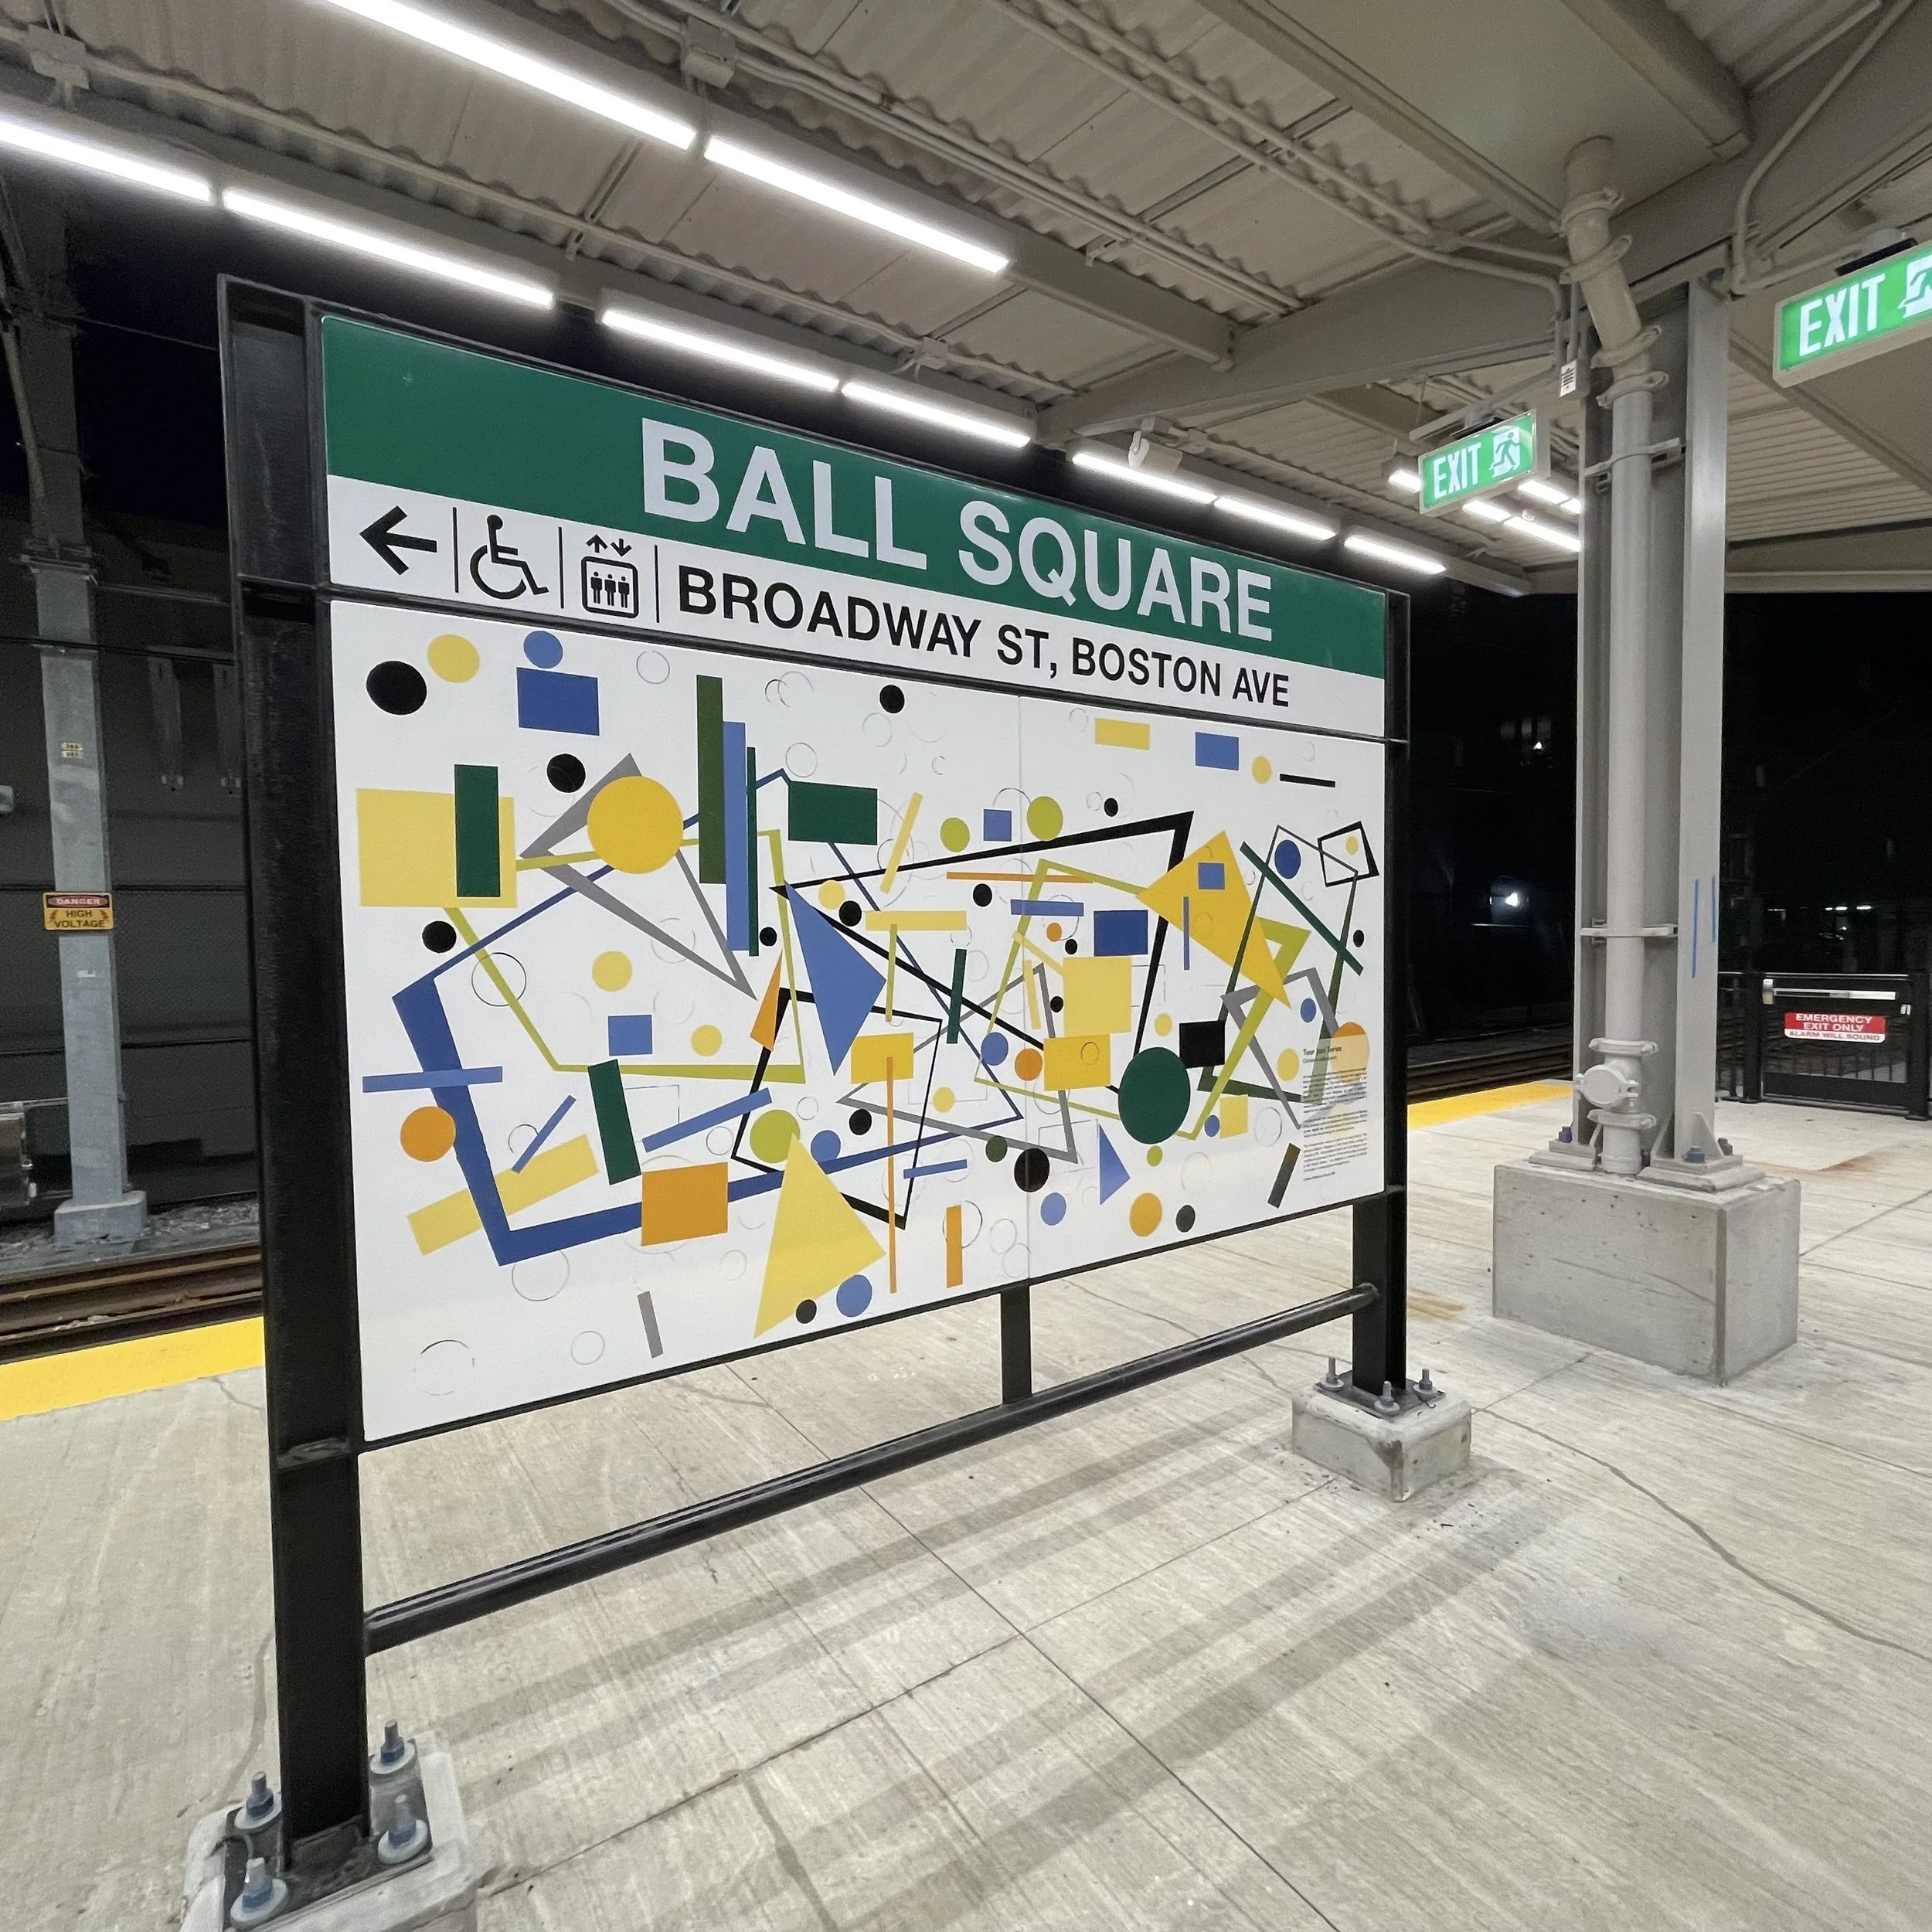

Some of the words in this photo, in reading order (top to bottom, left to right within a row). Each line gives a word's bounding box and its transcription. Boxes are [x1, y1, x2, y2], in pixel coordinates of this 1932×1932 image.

[1799, 274, 1886, 356] EXIT
[1434, 442, 1481, 499] EXIT
[642, 417, 927, 570] BALL
[958, 500, 1272, 642] SQUARE
[679, 565, 981, 658] BROADWAY
[997, 624, 1057, 679] ST,
[1073, 637, 1221, 697] BOSTON
[1233, 667, 1289, 707] AVE
[54, 920, 106, 928] VOLTAGE
[66, 910, 93, 918] HIGH
[1795, 1013, 1872, 1024] EMERGENCY
[1803, 1022, 1829, 1030] EXIT
[1832, 1023, 1864, 1032] ONLY
